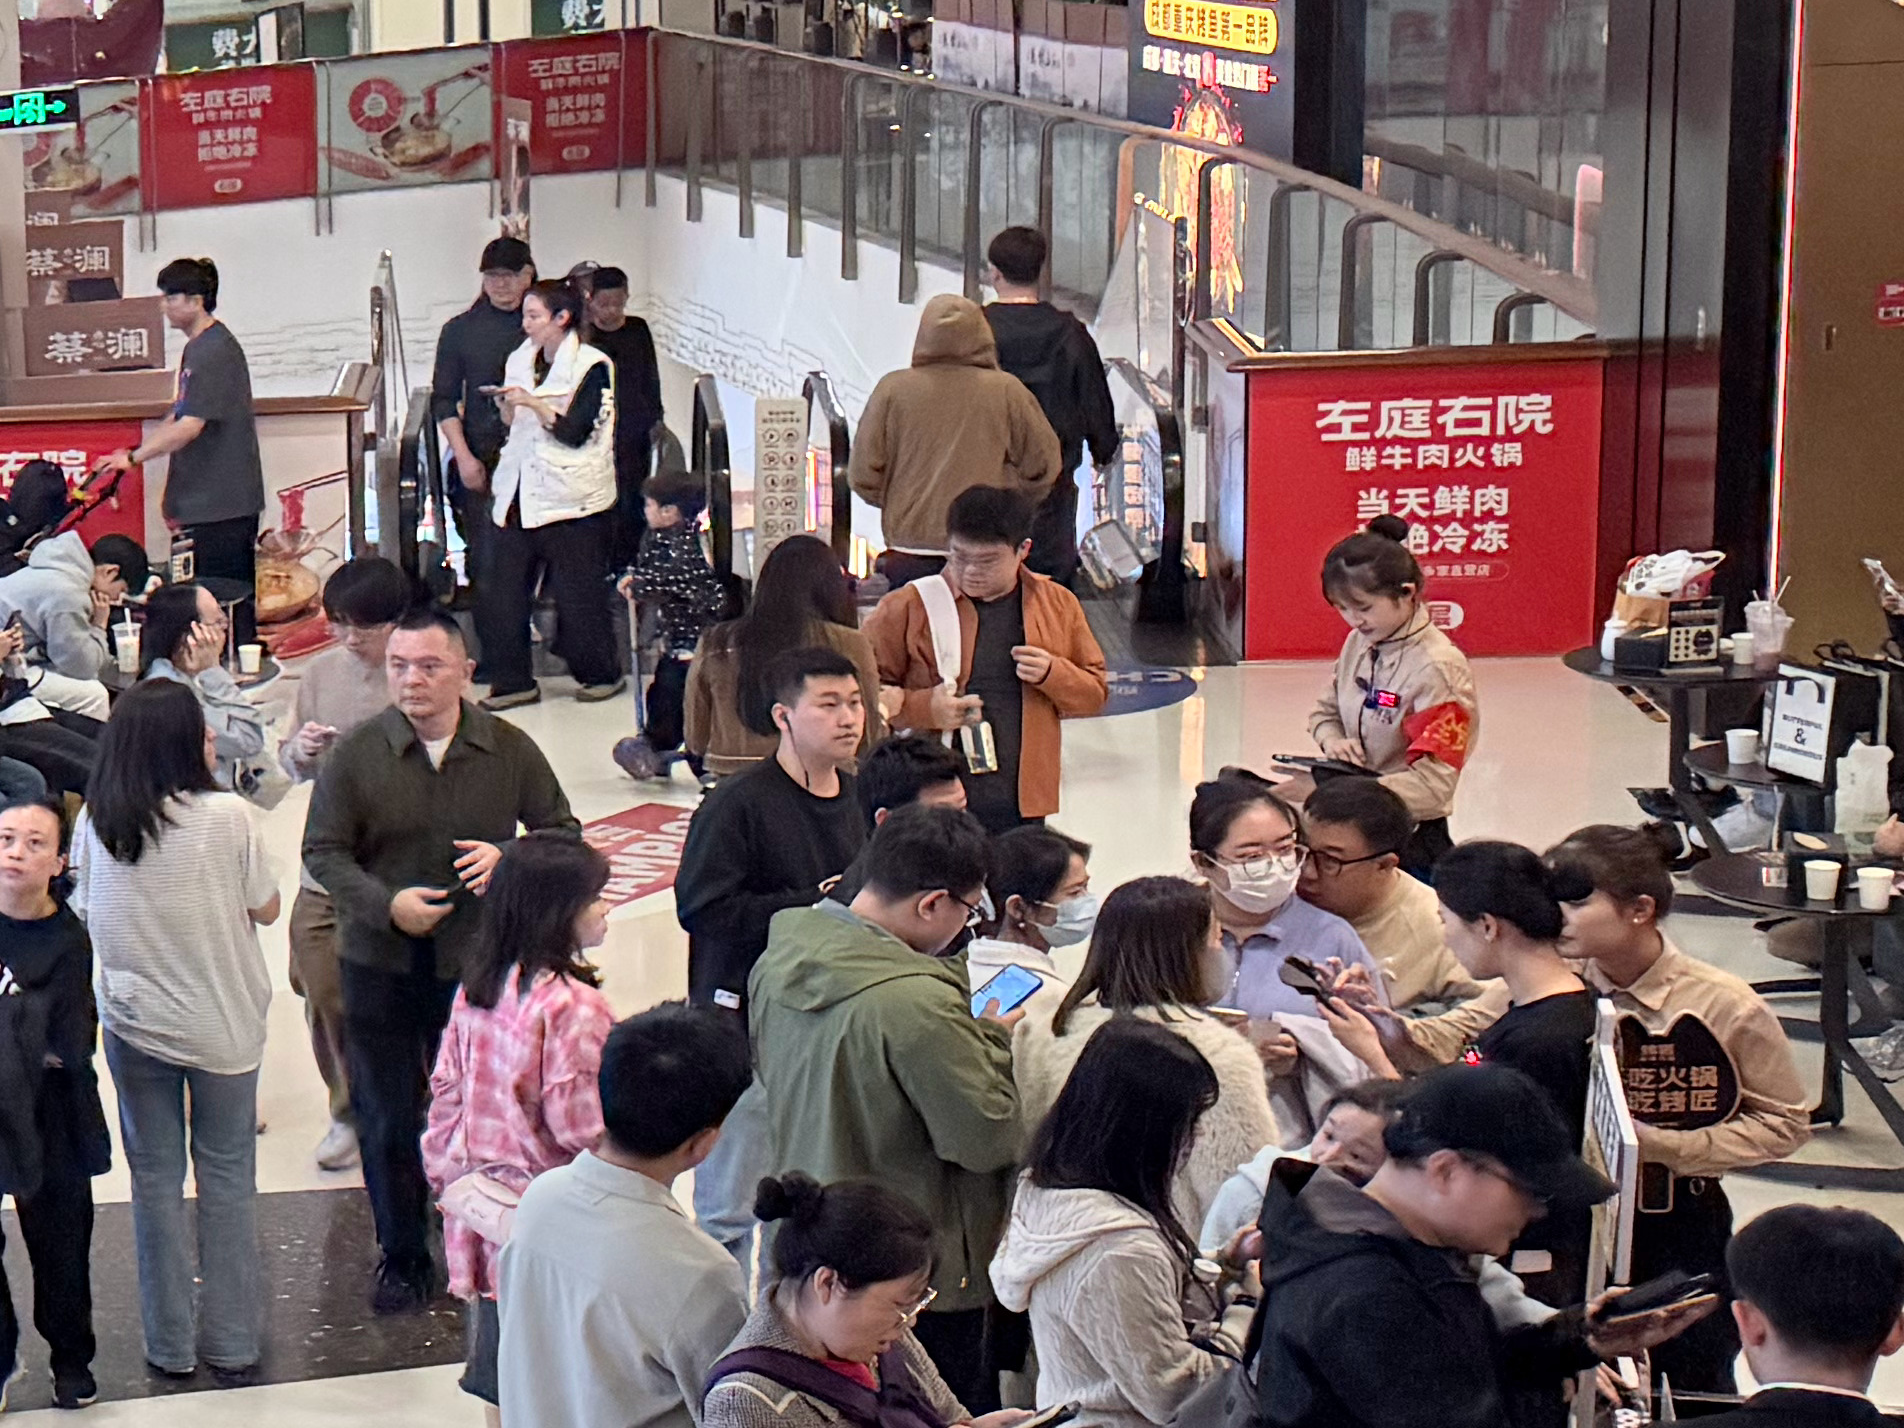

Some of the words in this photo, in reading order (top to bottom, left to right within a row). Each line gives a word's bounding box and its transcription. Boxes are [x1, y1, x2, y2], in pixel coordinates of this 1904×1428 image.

[44, 327, 149, 364] 蔡澜
[1315, 393, 1555, 442] 左庭右院
[1344, 441, 1524, 472] 鲜牛肉火锅
[1356, 483, 1510, 519] 当天鲜肉
[1794, 727, 1807, 746] &
[1620, 1065, 1718, 1090] 吃火锅
[1625, 1089, 1718, 1113] 吃烤匠
